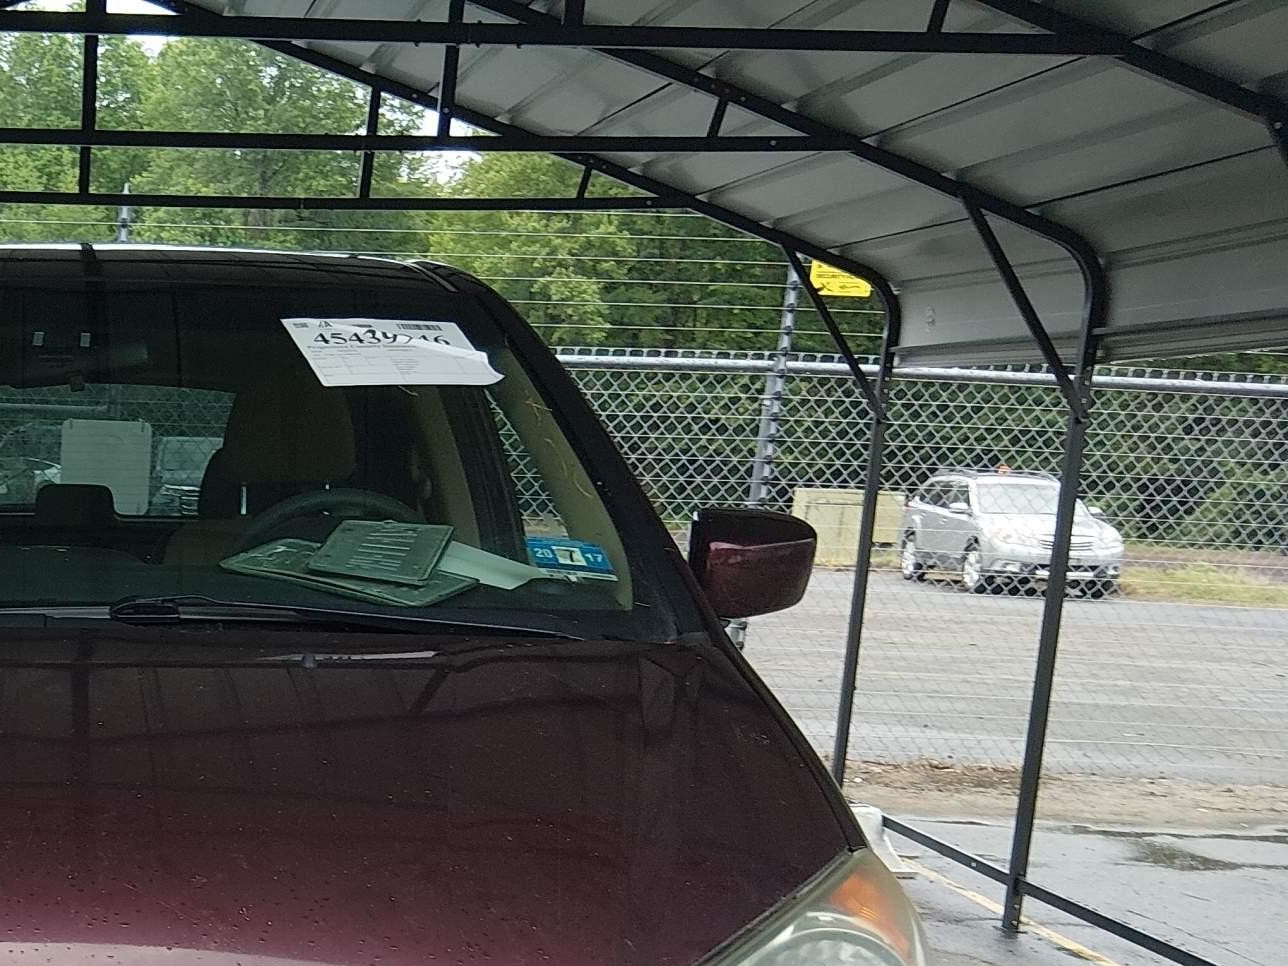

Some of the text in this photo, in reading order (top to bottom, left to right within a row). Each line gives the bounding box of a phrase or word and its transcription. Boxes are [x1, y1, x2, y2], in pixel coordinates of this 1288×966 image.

[533, 547, 602, 563] 20 7 17
